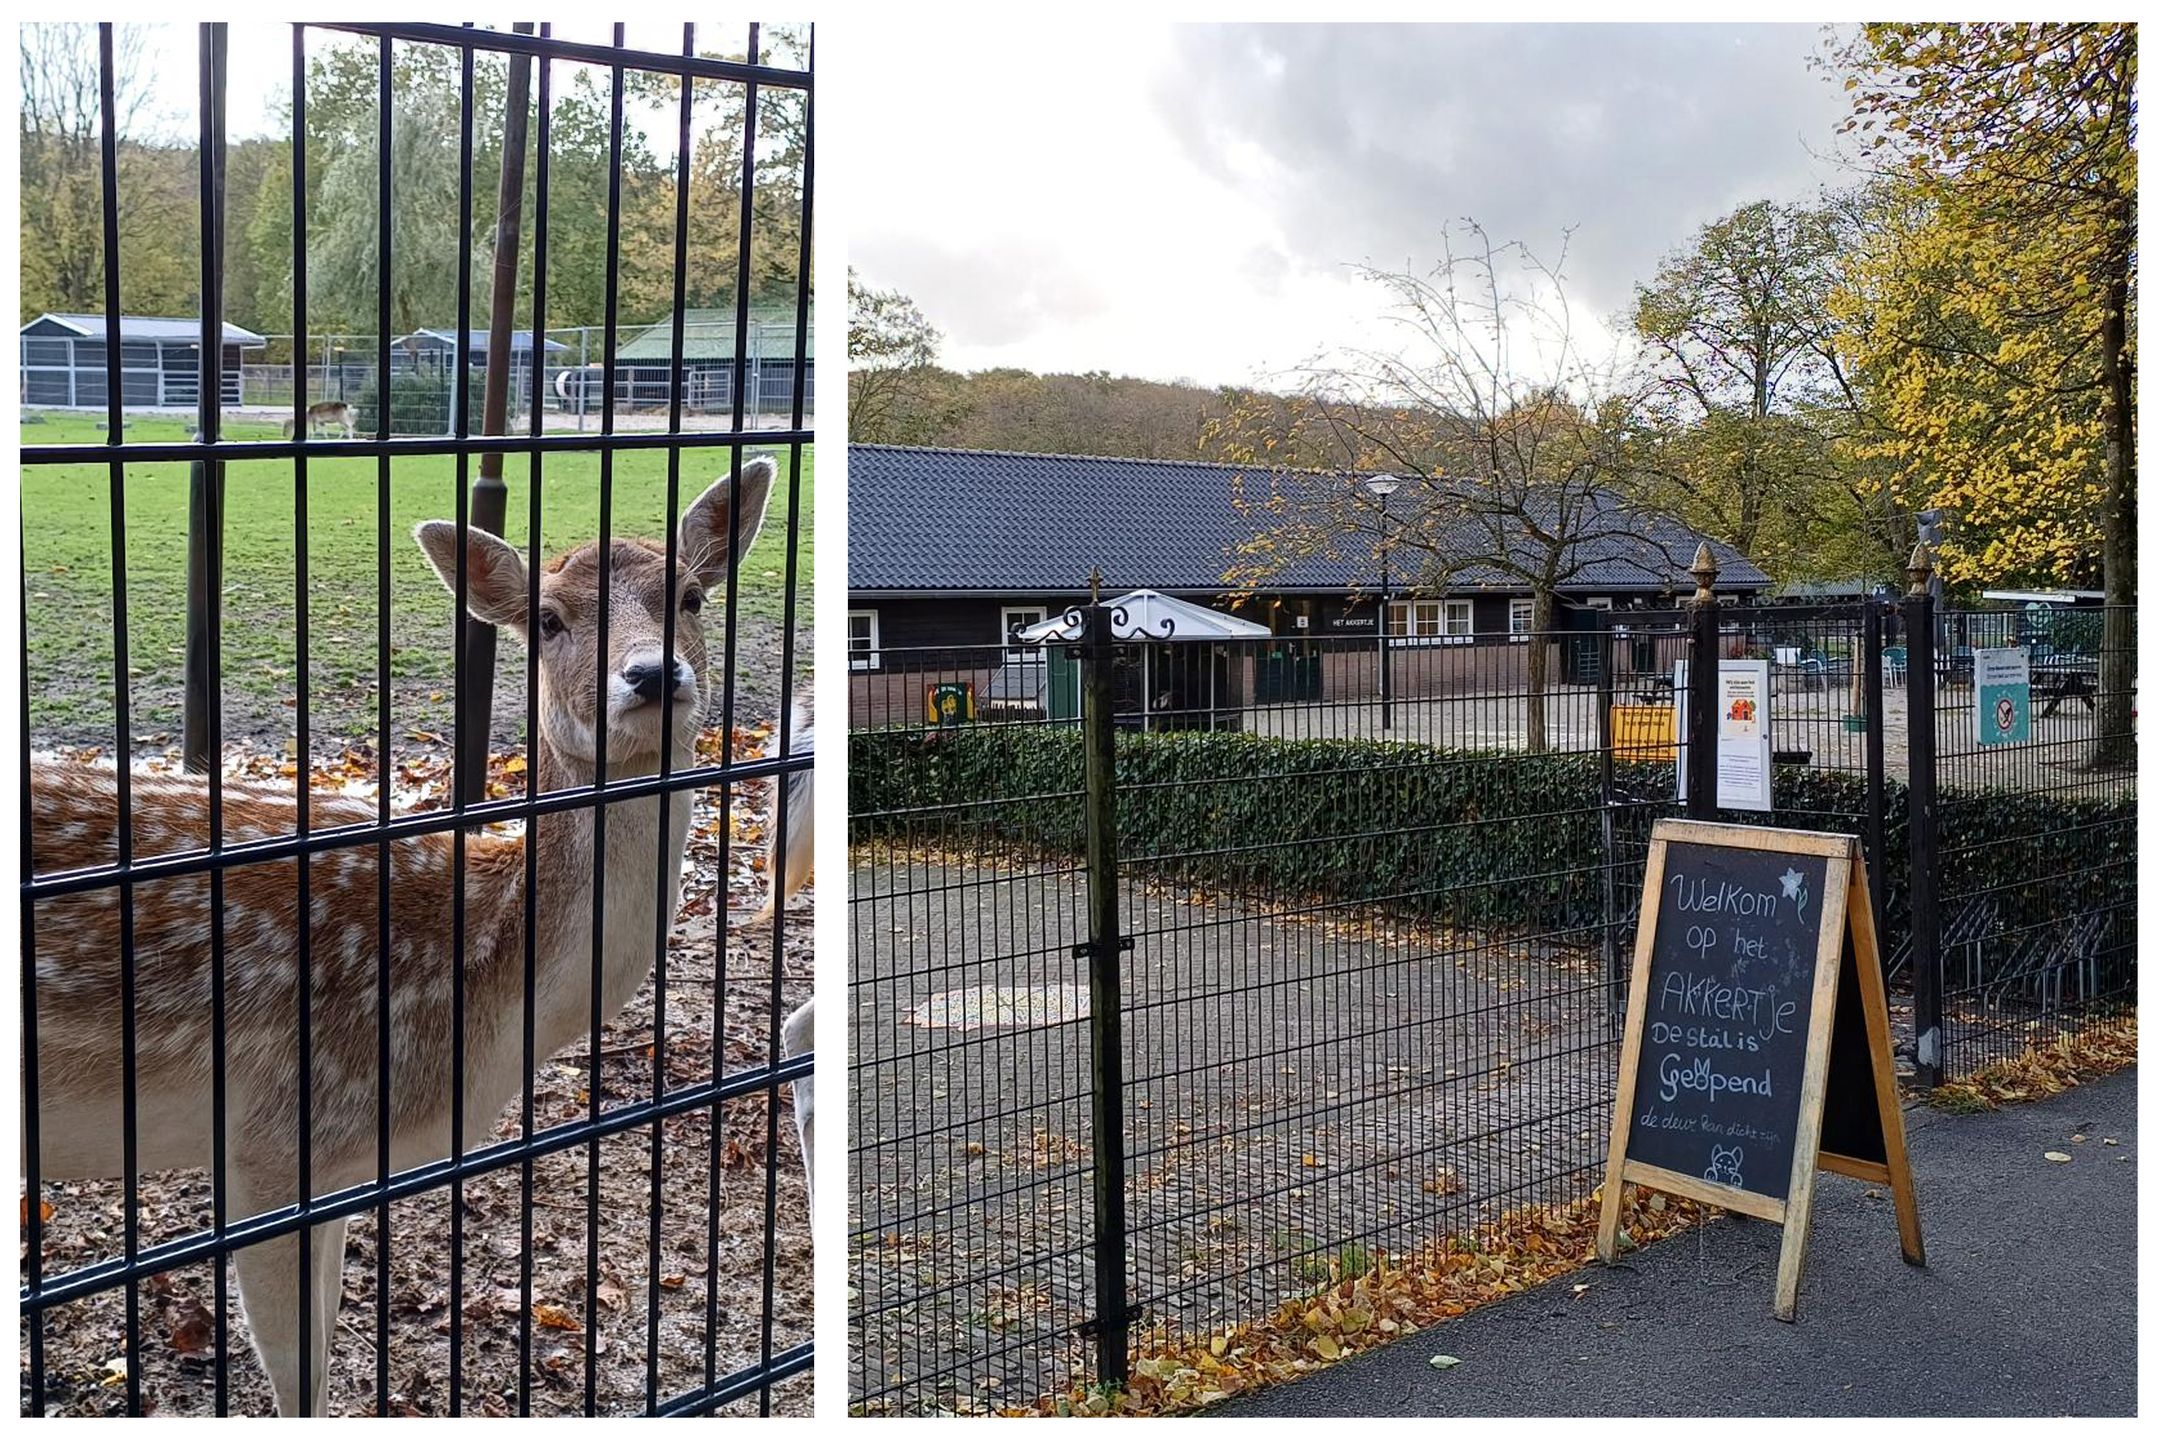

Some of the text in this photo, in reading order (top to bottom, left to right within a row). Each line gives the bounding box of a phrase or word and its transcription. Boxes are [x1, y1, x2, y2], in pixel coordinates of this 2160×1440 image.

[1733, 928, 1768, 959] het
[1651, 1021, 1683, 1044] De
[1737, 1032, 1760, 1052] is
[1640, 1105, 1659, 1128] de
[1662, 1112, 1697, 1132] deur
[1726, 1117, 1757, 1139] dicht
